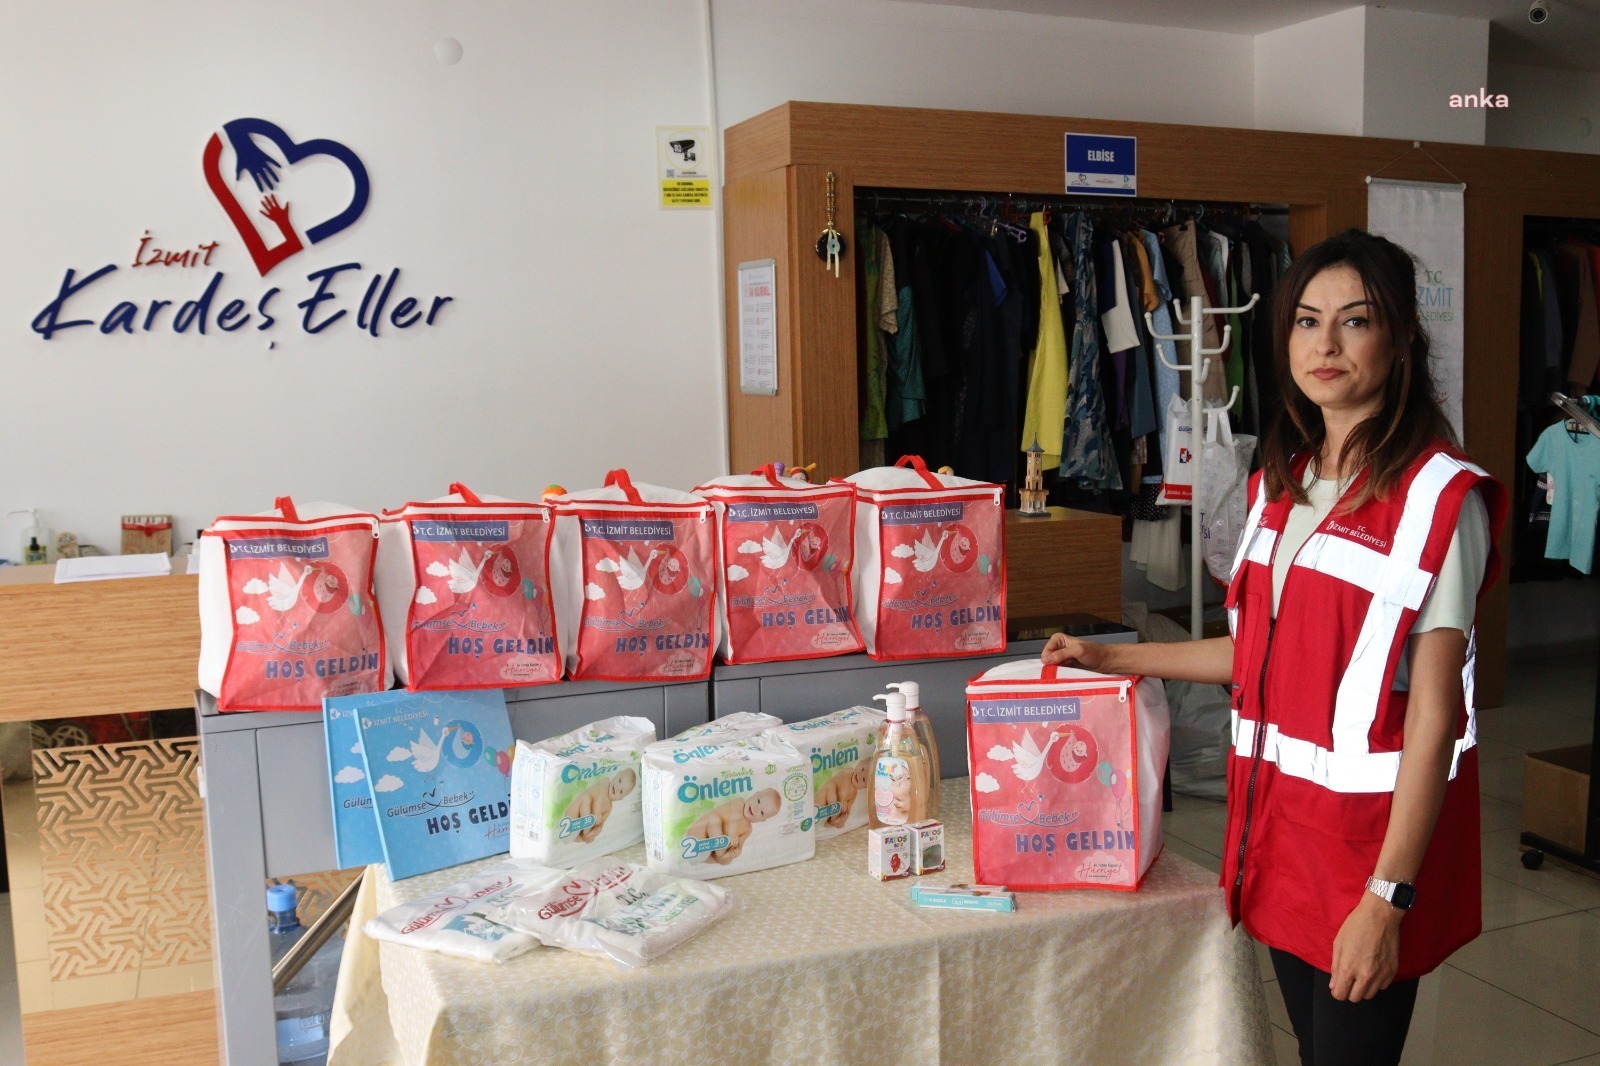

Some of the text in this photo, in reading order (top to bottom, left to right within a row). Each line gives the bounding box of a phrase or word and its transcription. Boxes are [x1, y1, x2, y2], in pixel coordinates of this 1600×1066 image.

[1087, 149, 1115, 162] ELBİSE
[131, 229, 222, 268] İzmit
[30, 262, 454, 350] Kardeş Eller
[1415, 283, 1454, 307] ZMİT
[750, 507, 771, 517] İZMİT
[773, 505, 815, 515] BELEDİYESİ
[903, 509, 922, 519] İZMİT
[923, 507, 961, 518] BELEDİYESİ
[420, 525, 505, 537] T.C. İZMİT BELEDİYESİ
[606, 524, 628, 535] İZMİT
[629, 525, 671, 535] BELEDİYESİ
[1332, 523, 1388, 548] İZMİT BELEDİYESİ
[250, 542, 275, 554] İZMİT
[277, 541, 326, 554] BELEDİYESİ
[762, 610, 795, 630] HOŞ
[911, 599, 1001, 633] HOŞ GELDİN
[447, 631, 554, 659] HOŞ GELDİN
[615, 627, 709, 656] HOŞ GELDİN
[265, 648, 379, 681] HOŞ GELDİN
[393, 709, 429, 723] BELEDİYESİ
[980, 702, 1077, 717] T.C. İZMİT BELEDİYESİ
[810, 746, 859, 774] Önlem
[677, 775, 753, 804] Önlem
[387, 791, 468, 818] Gülümse Bebek
[426, 797, 510, 835] HOŞ GELD
[559, 816, 572, 839] 2
[1039, 811, 1070, 822] Bebek
[681, 836, 698, 859] 2
[714, 837, 725, 845] 30
[1015, 822, 1135, 857] HOŞ GELDİN
